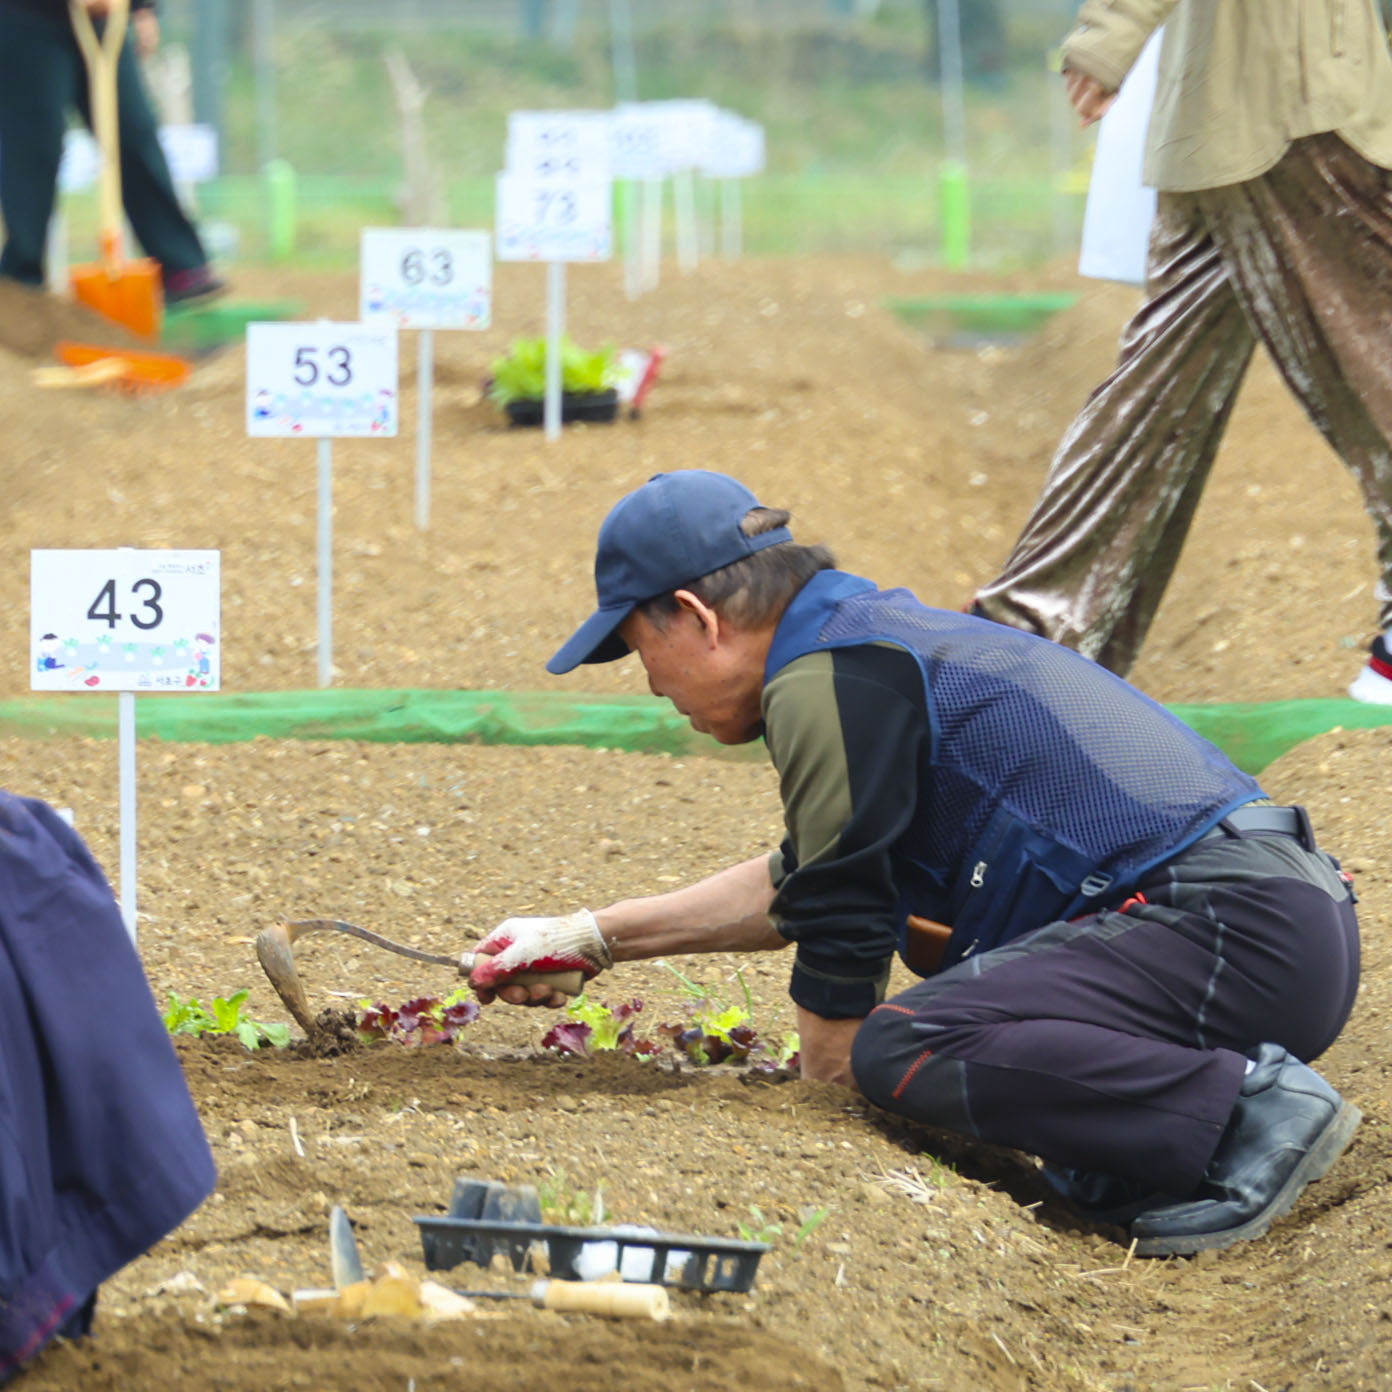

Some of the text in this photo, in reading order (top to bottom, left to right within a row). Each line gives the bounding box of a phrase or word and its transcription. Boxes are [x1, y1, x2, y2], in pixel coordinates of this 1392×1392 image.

[532, 190, 578, 224] 73
[400, 249, 454, 287] 63
[294, 346, 353, 387] 53
[87, 578, 163, 630] 43
